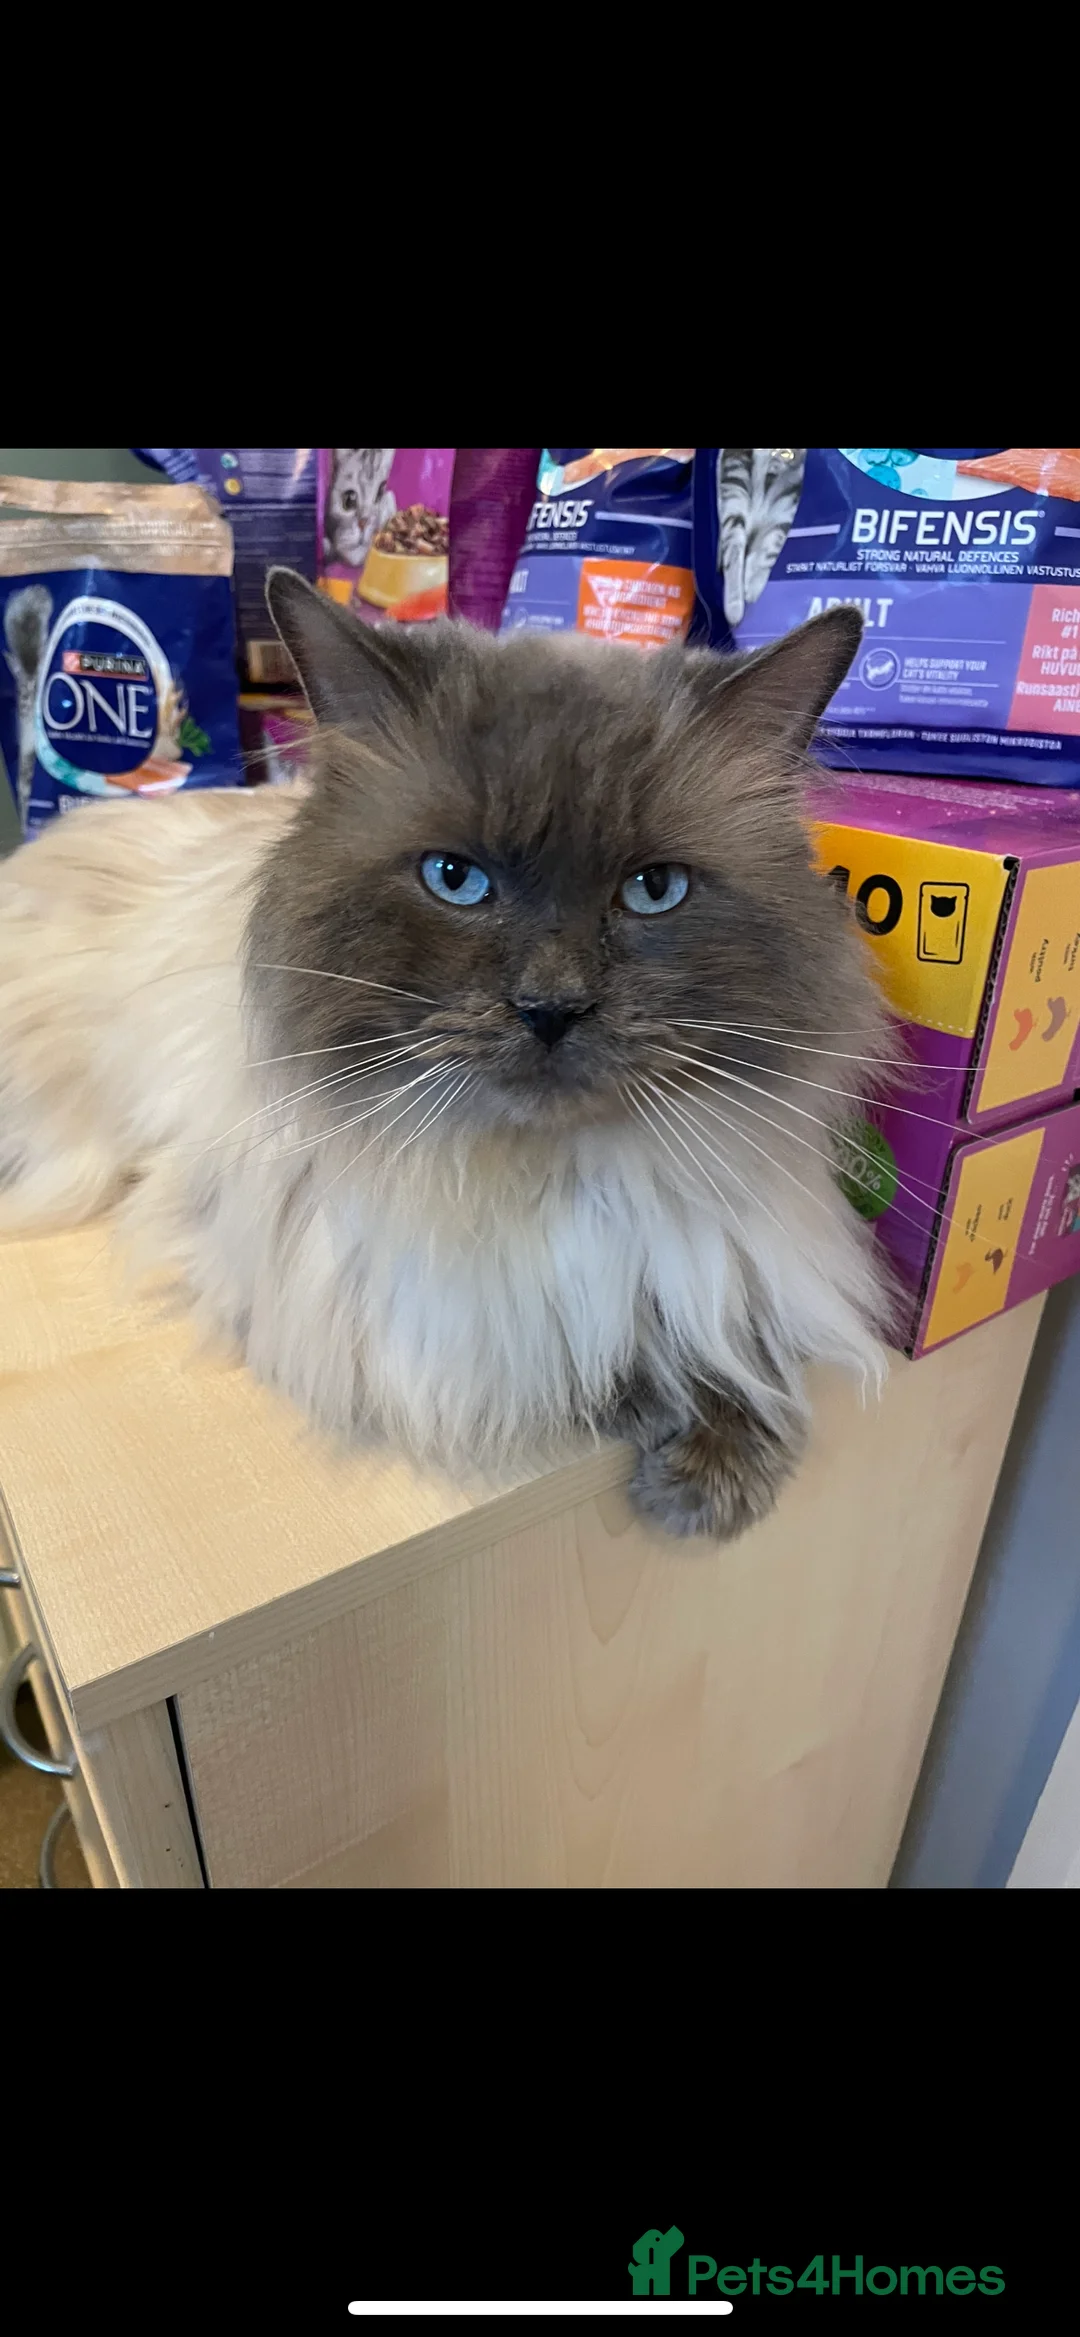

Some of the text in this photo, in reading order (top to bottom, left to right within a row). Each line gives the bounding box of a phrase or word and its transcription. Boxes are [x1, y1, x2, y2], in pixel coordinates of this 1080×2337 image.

[852, 508, 1039, 546] BIFENSIS
[856, 549, 1019, 563] STRONG NATURAL DEFENCES
[915, 563, 946, 573] VAHVA
[807, 596, 893, 628] ALT
[1032, 645, 1058, 659] Rikt
[81, 655, 145, 674] PURINA
[929, 658, 964, 670] SUPPORT
[43, 672, 154, 738] ONE
